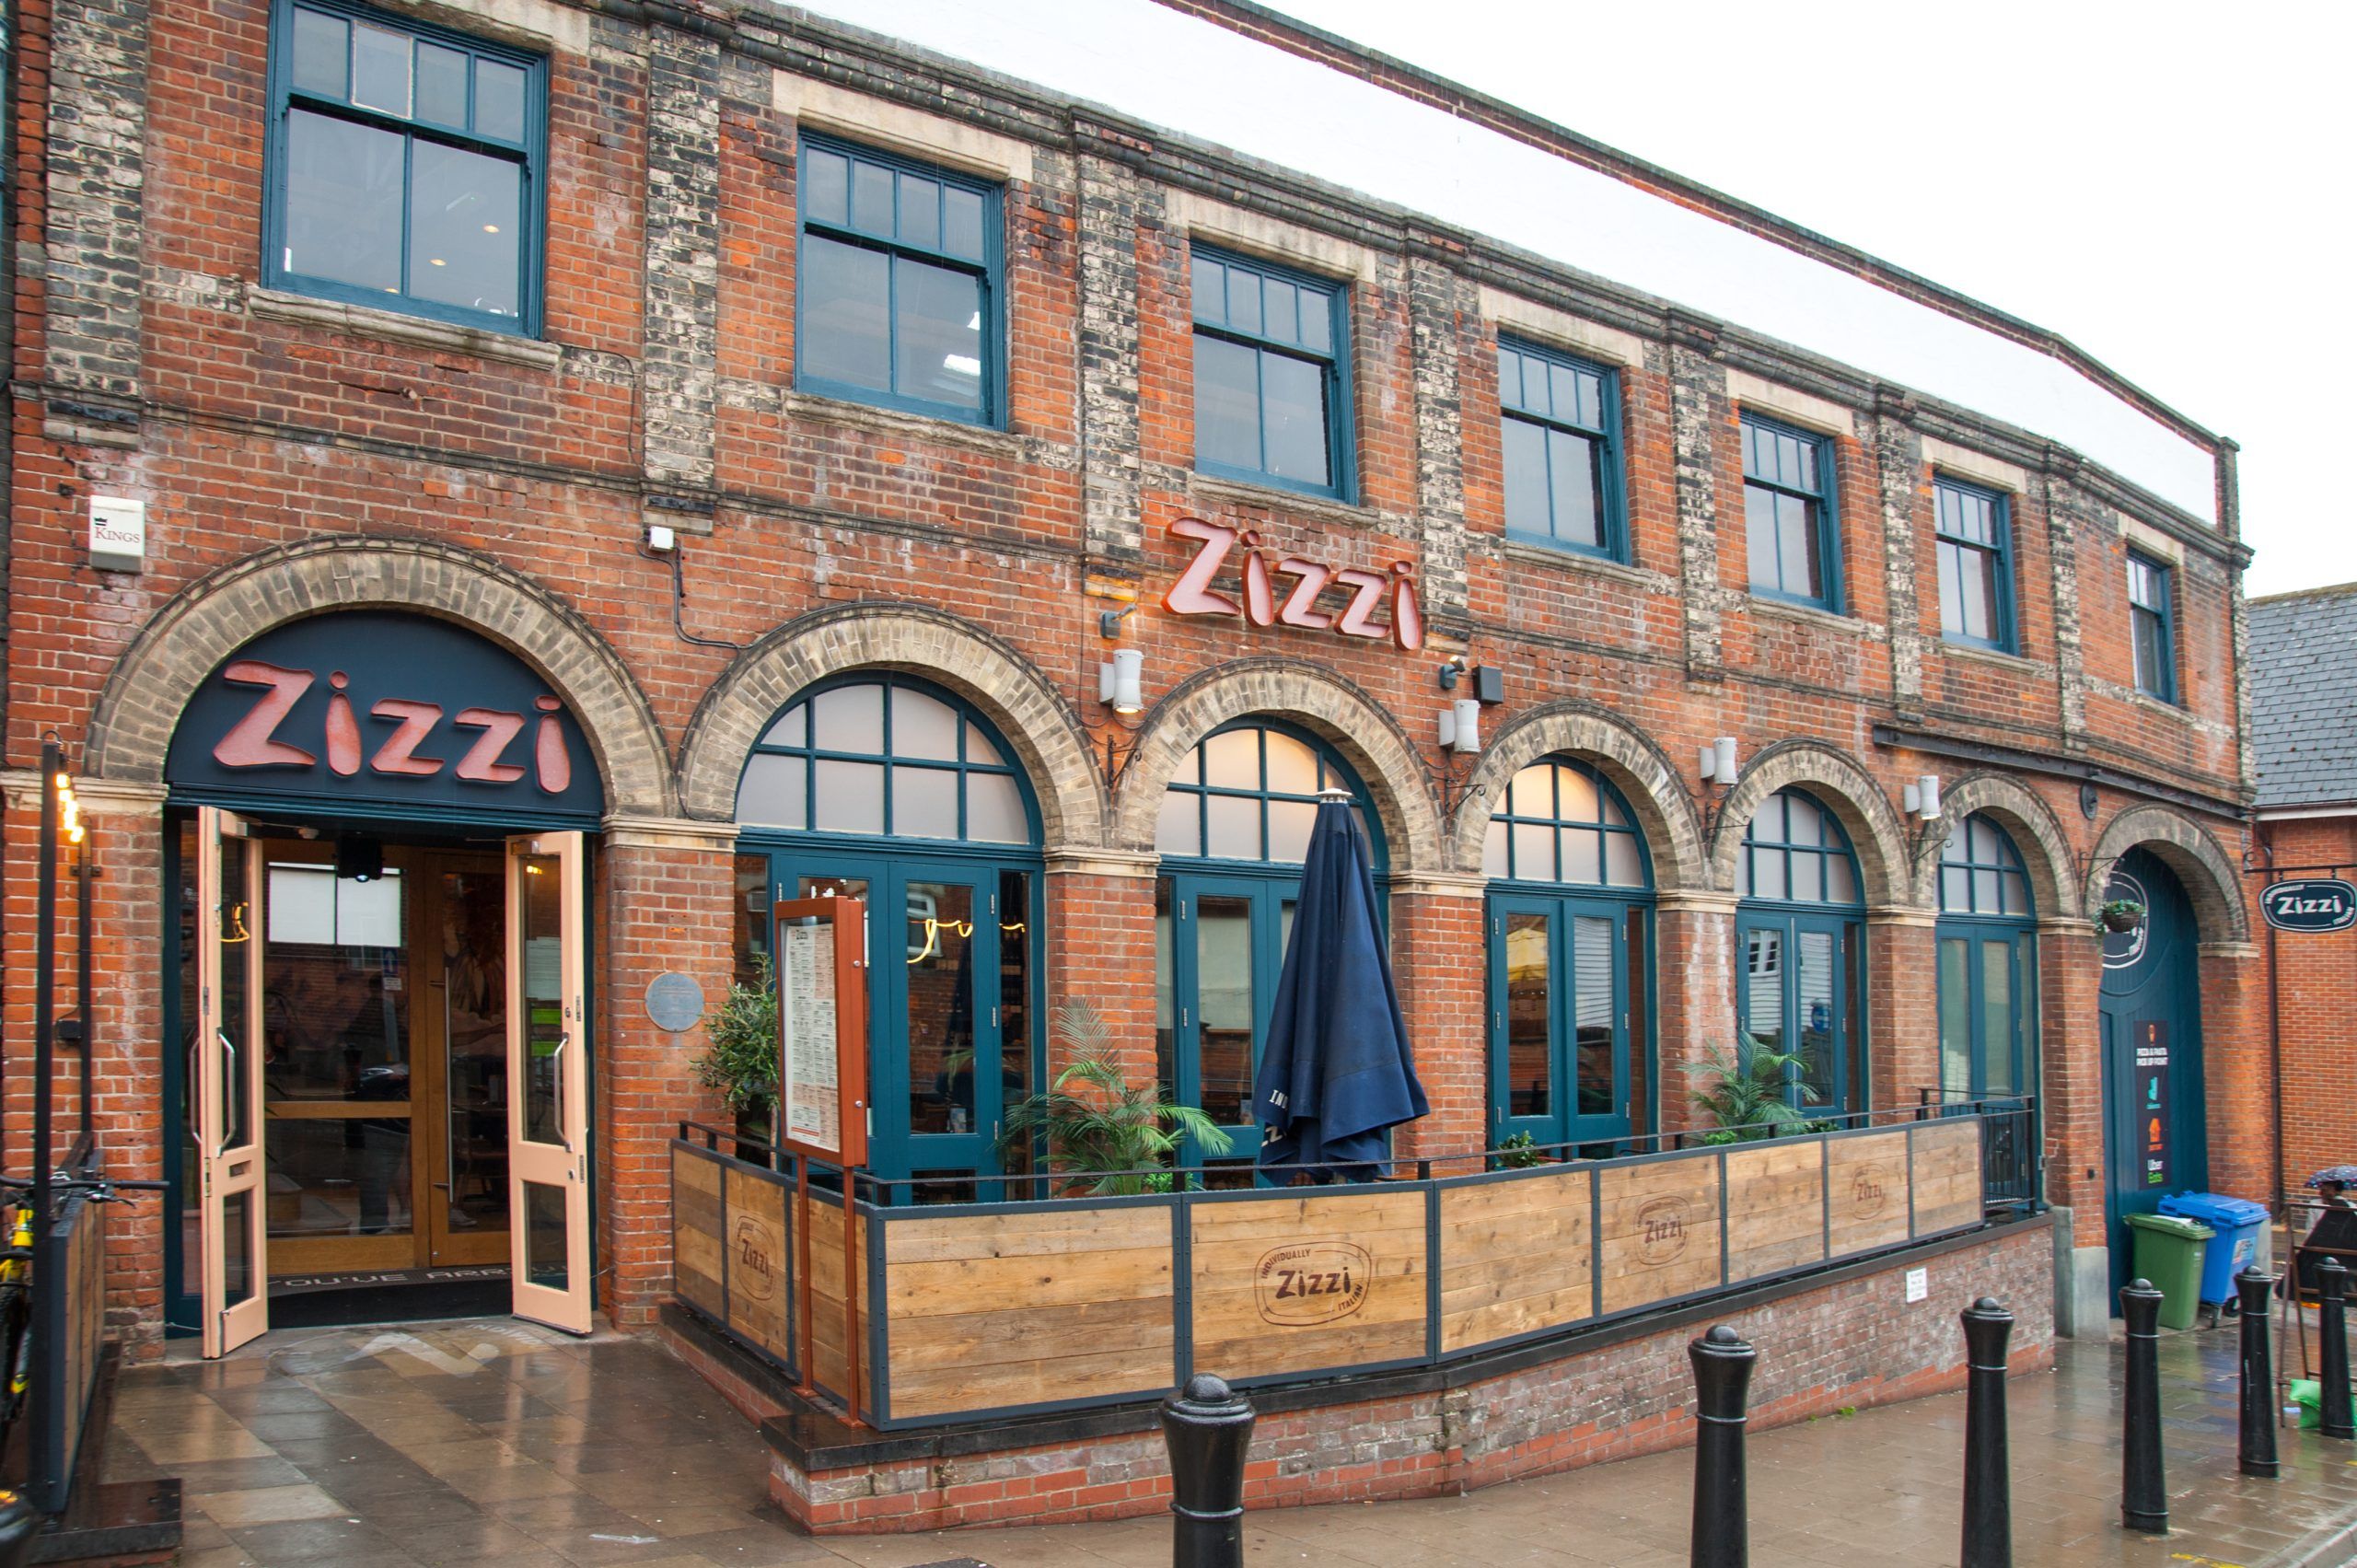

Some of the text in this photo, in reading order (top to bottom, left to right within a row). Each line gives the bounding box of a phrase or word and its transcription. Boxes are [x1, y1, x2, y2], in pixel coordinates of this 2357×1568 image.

[1160, 516, 1422, 651] Zizzi
[214, 659, 572, 794] Zizzi
[2276, 895, 2342, 915] Zizzi
[1261, 1249, 1311, 1279] INDIVIDUALLY
[1275, 1266, 1351, 1299] Zizzi
[1338, 1283, 1364, 1312] ITALIAN
